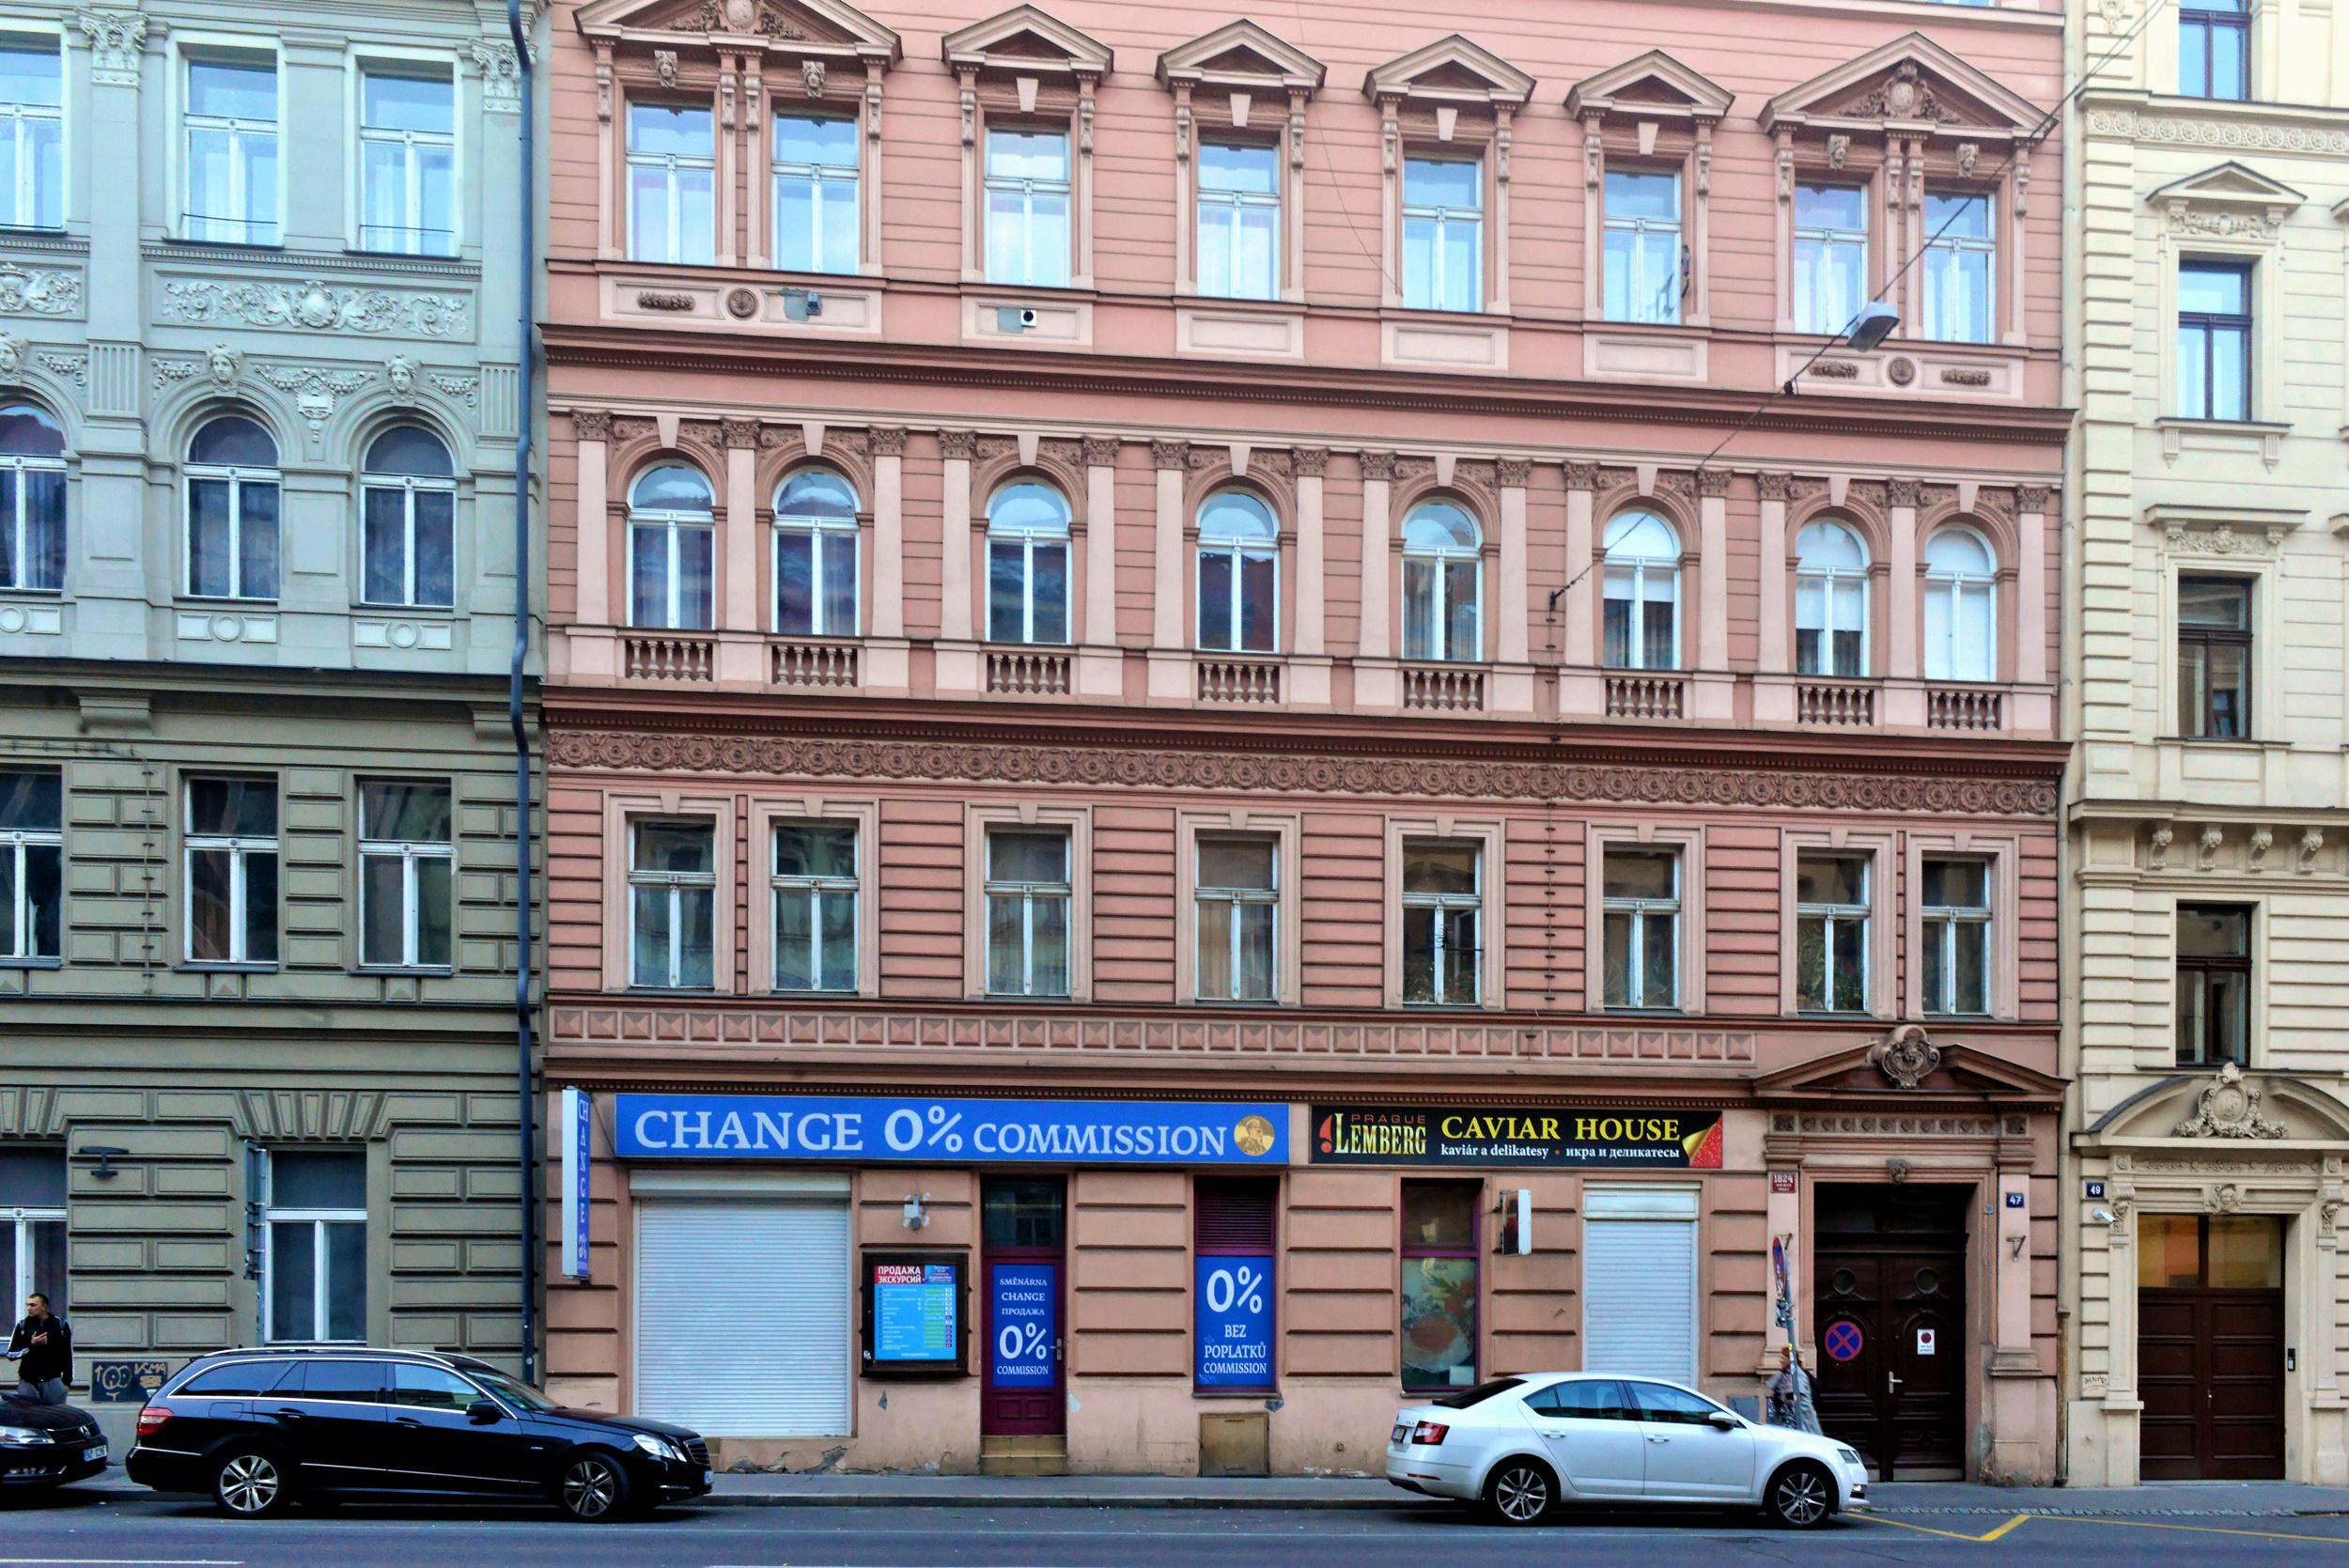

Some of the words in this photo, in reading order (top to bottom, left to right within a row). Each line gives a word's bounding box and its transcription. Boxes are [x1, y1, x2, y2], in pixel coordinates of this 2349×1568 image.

[1351, 1113, 1426, 1125] PRAGUE
[634, 1110, 863, 1151] CHANGE
[884, 1105, 963, 1153] 0%
[973, 1123, 1227, 1156] COMMISSION
[1334, 1112, 1427, 1155] LEMBERG
[1441, 1116, 1561, 1140] CAVIAR
[1575, 1118, 1680, 1141] HOUSE
[1440, 1143, 1478, 1156] kaviár
[1481, 1147, 1487, 1156] a
[1490, 1143, 1548, 1159] delikatesy
[1565, 1147, 1595, 1159] икра
[1598, 1148, 1607, 1157] и
[1609, 1148, 1680, 1159] деликатесы
[2091, 1185, 2101, 1195] 49
[2009, 1195, 2021, 1205] 47
[878, 1265, 921, 1275] ПРОДАЖА
[878, 1274, 922, 1283] ЭКСКУРСИЙ
[1206, 1265, 1263, 1313] 0%
[1002, 1293, 1046, 1301] CHANGE
[1002, 1308, 1045, 1316] ПРОДАЖА
[1224, 1324, 1247, 1338] BEZ
[999, 1322, 1047, 1359] 0%
[1204, 1341, 1267, 1358] POPLATKŮ
[997, 1365, 1049, 1375] COMMISSION
[1204, 1362, 1268, 1374] COMMISSION
